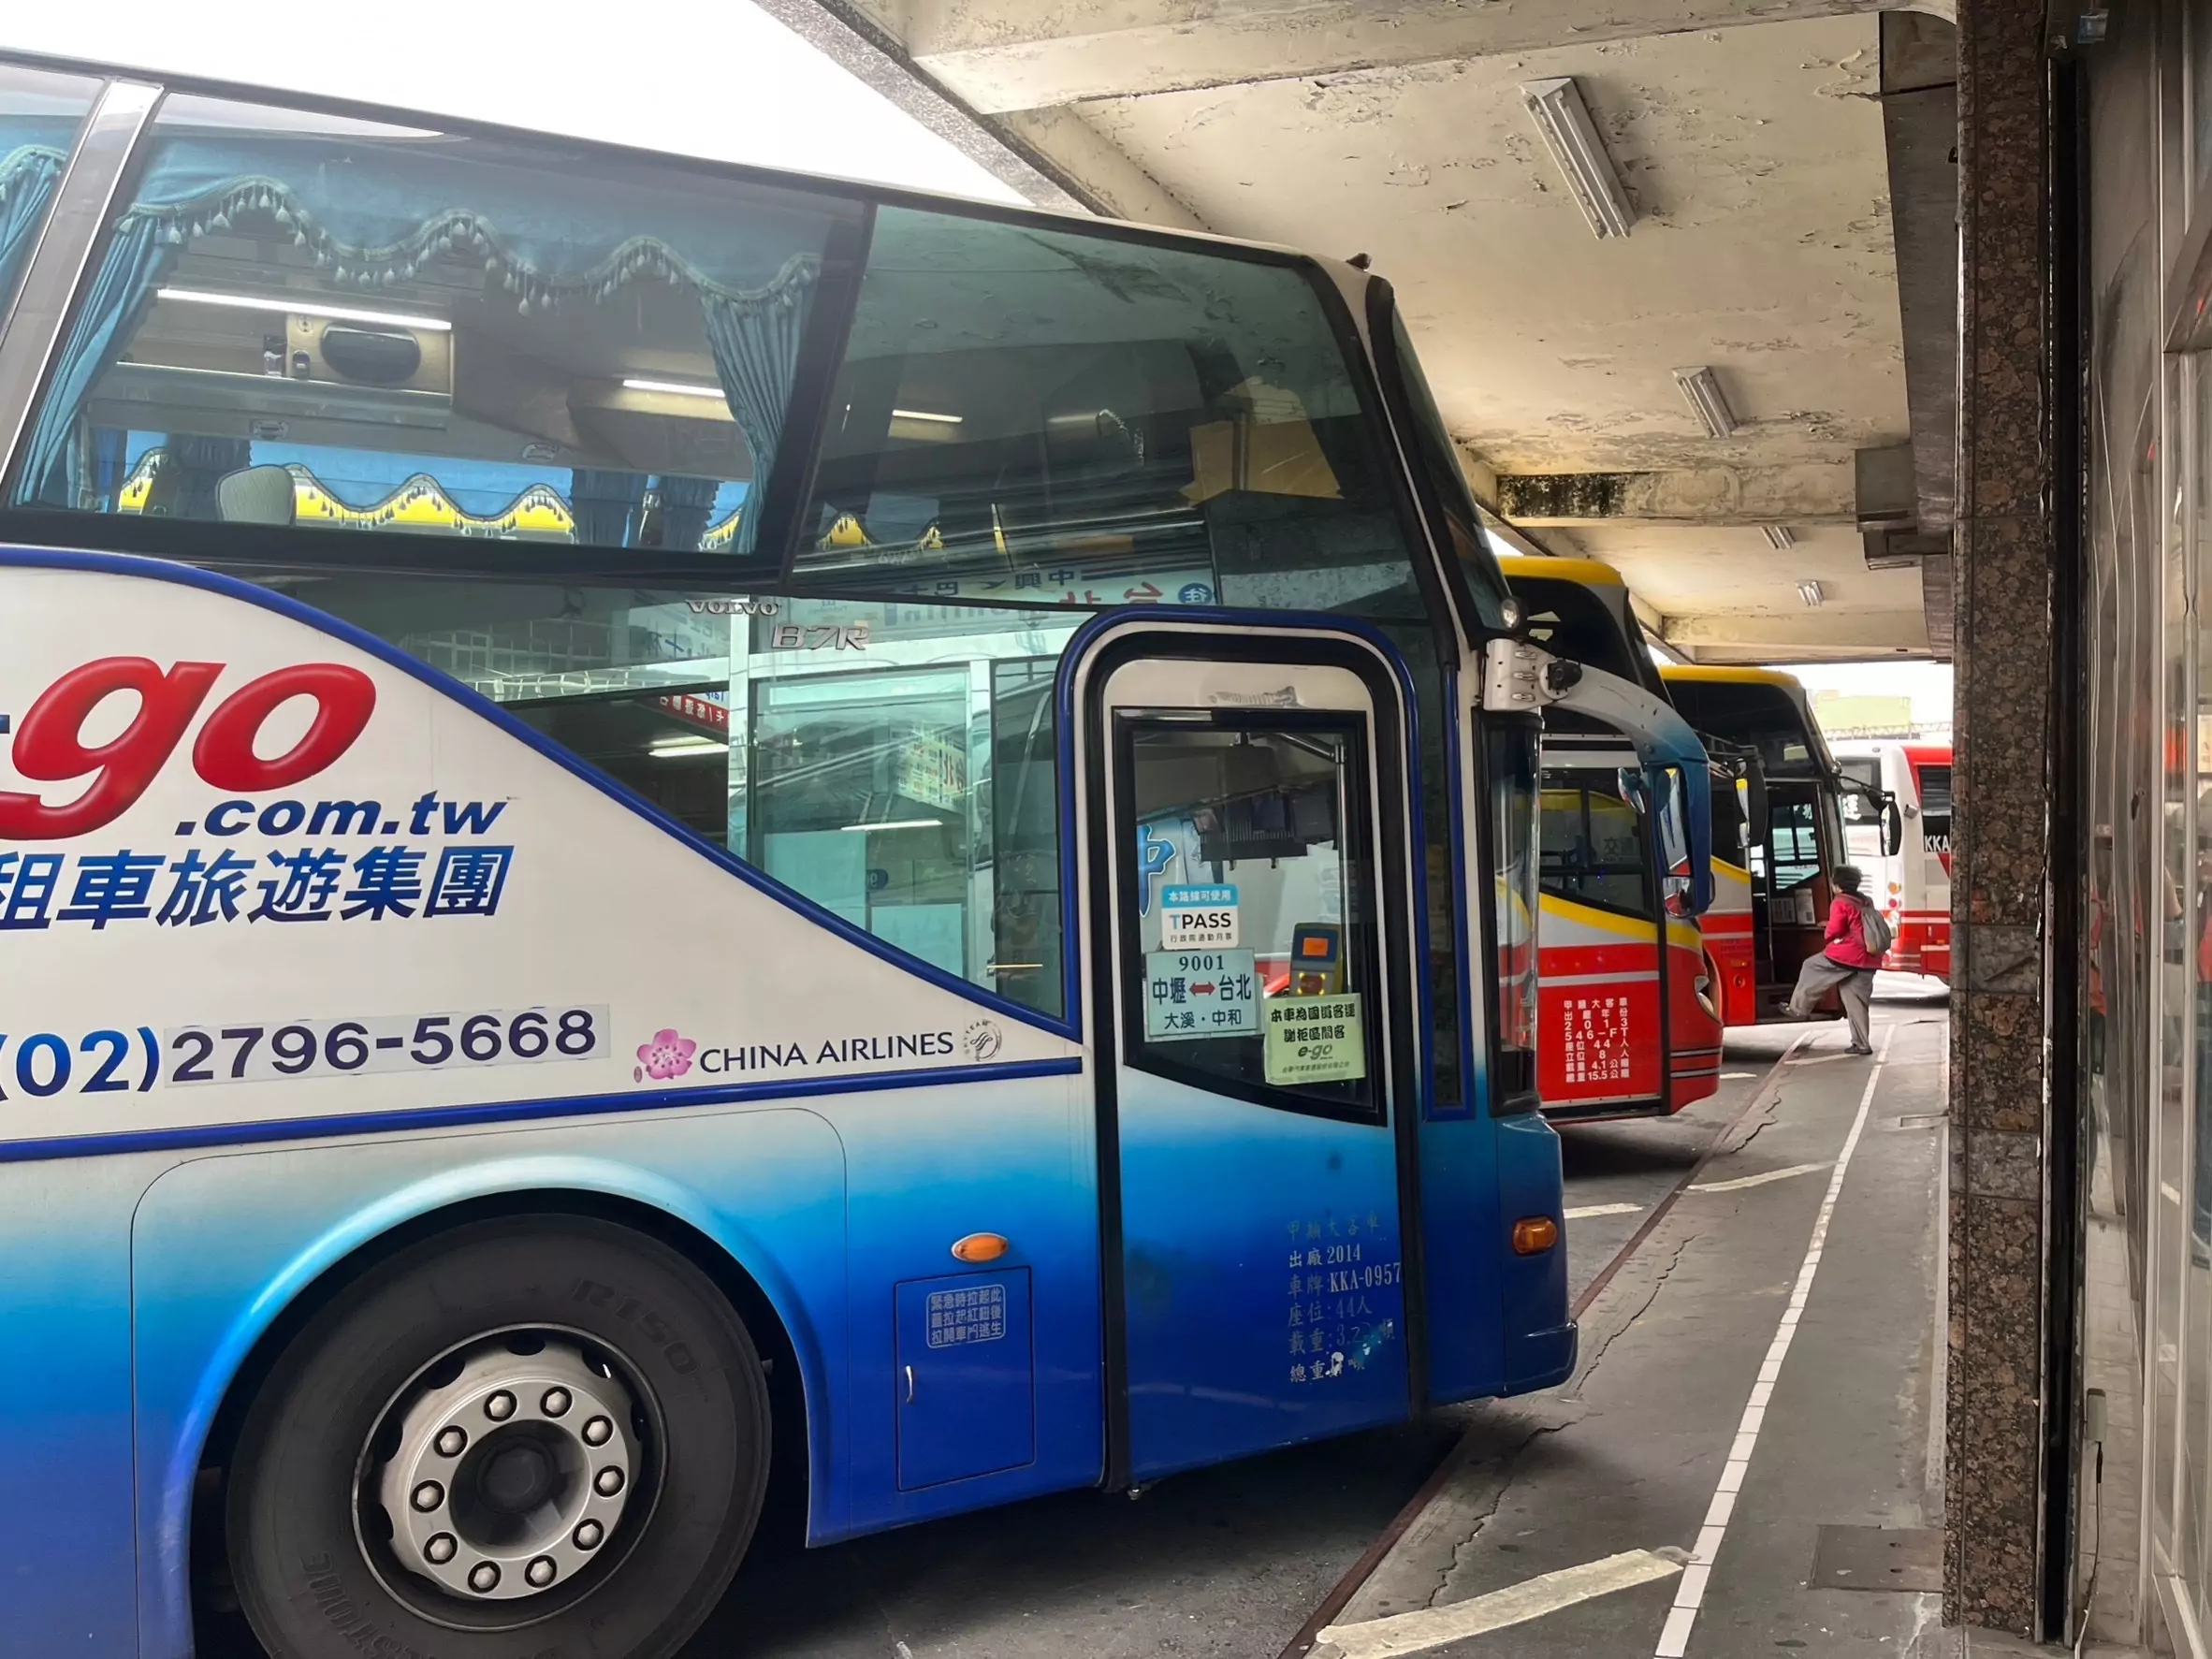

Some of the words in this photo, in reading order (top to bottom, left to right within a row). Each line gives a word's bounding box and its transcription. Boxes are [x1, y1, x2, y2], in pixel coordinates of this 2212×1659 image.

[685, 598, 780, 617] VOLVO
[772, 623, 870, 650] B7R
[0, 656, 377, 840] go
[174, 790, 508, 837] .com.tw
[0, 845, 516, 931] 租車旅遊集團
[1169, 912, 1232, 930] TPASS
[1178, 953, 1225, 972] 9001
[1152, 977, 1187, 1006] 中壢
[1218, 973, 1252, 1001] 台北
[699, 1041, 808, 1073] CHINA
[816, 1032, 953, 1065] AIRLINES
[1297, 1043, 1333, 1061] e-go
